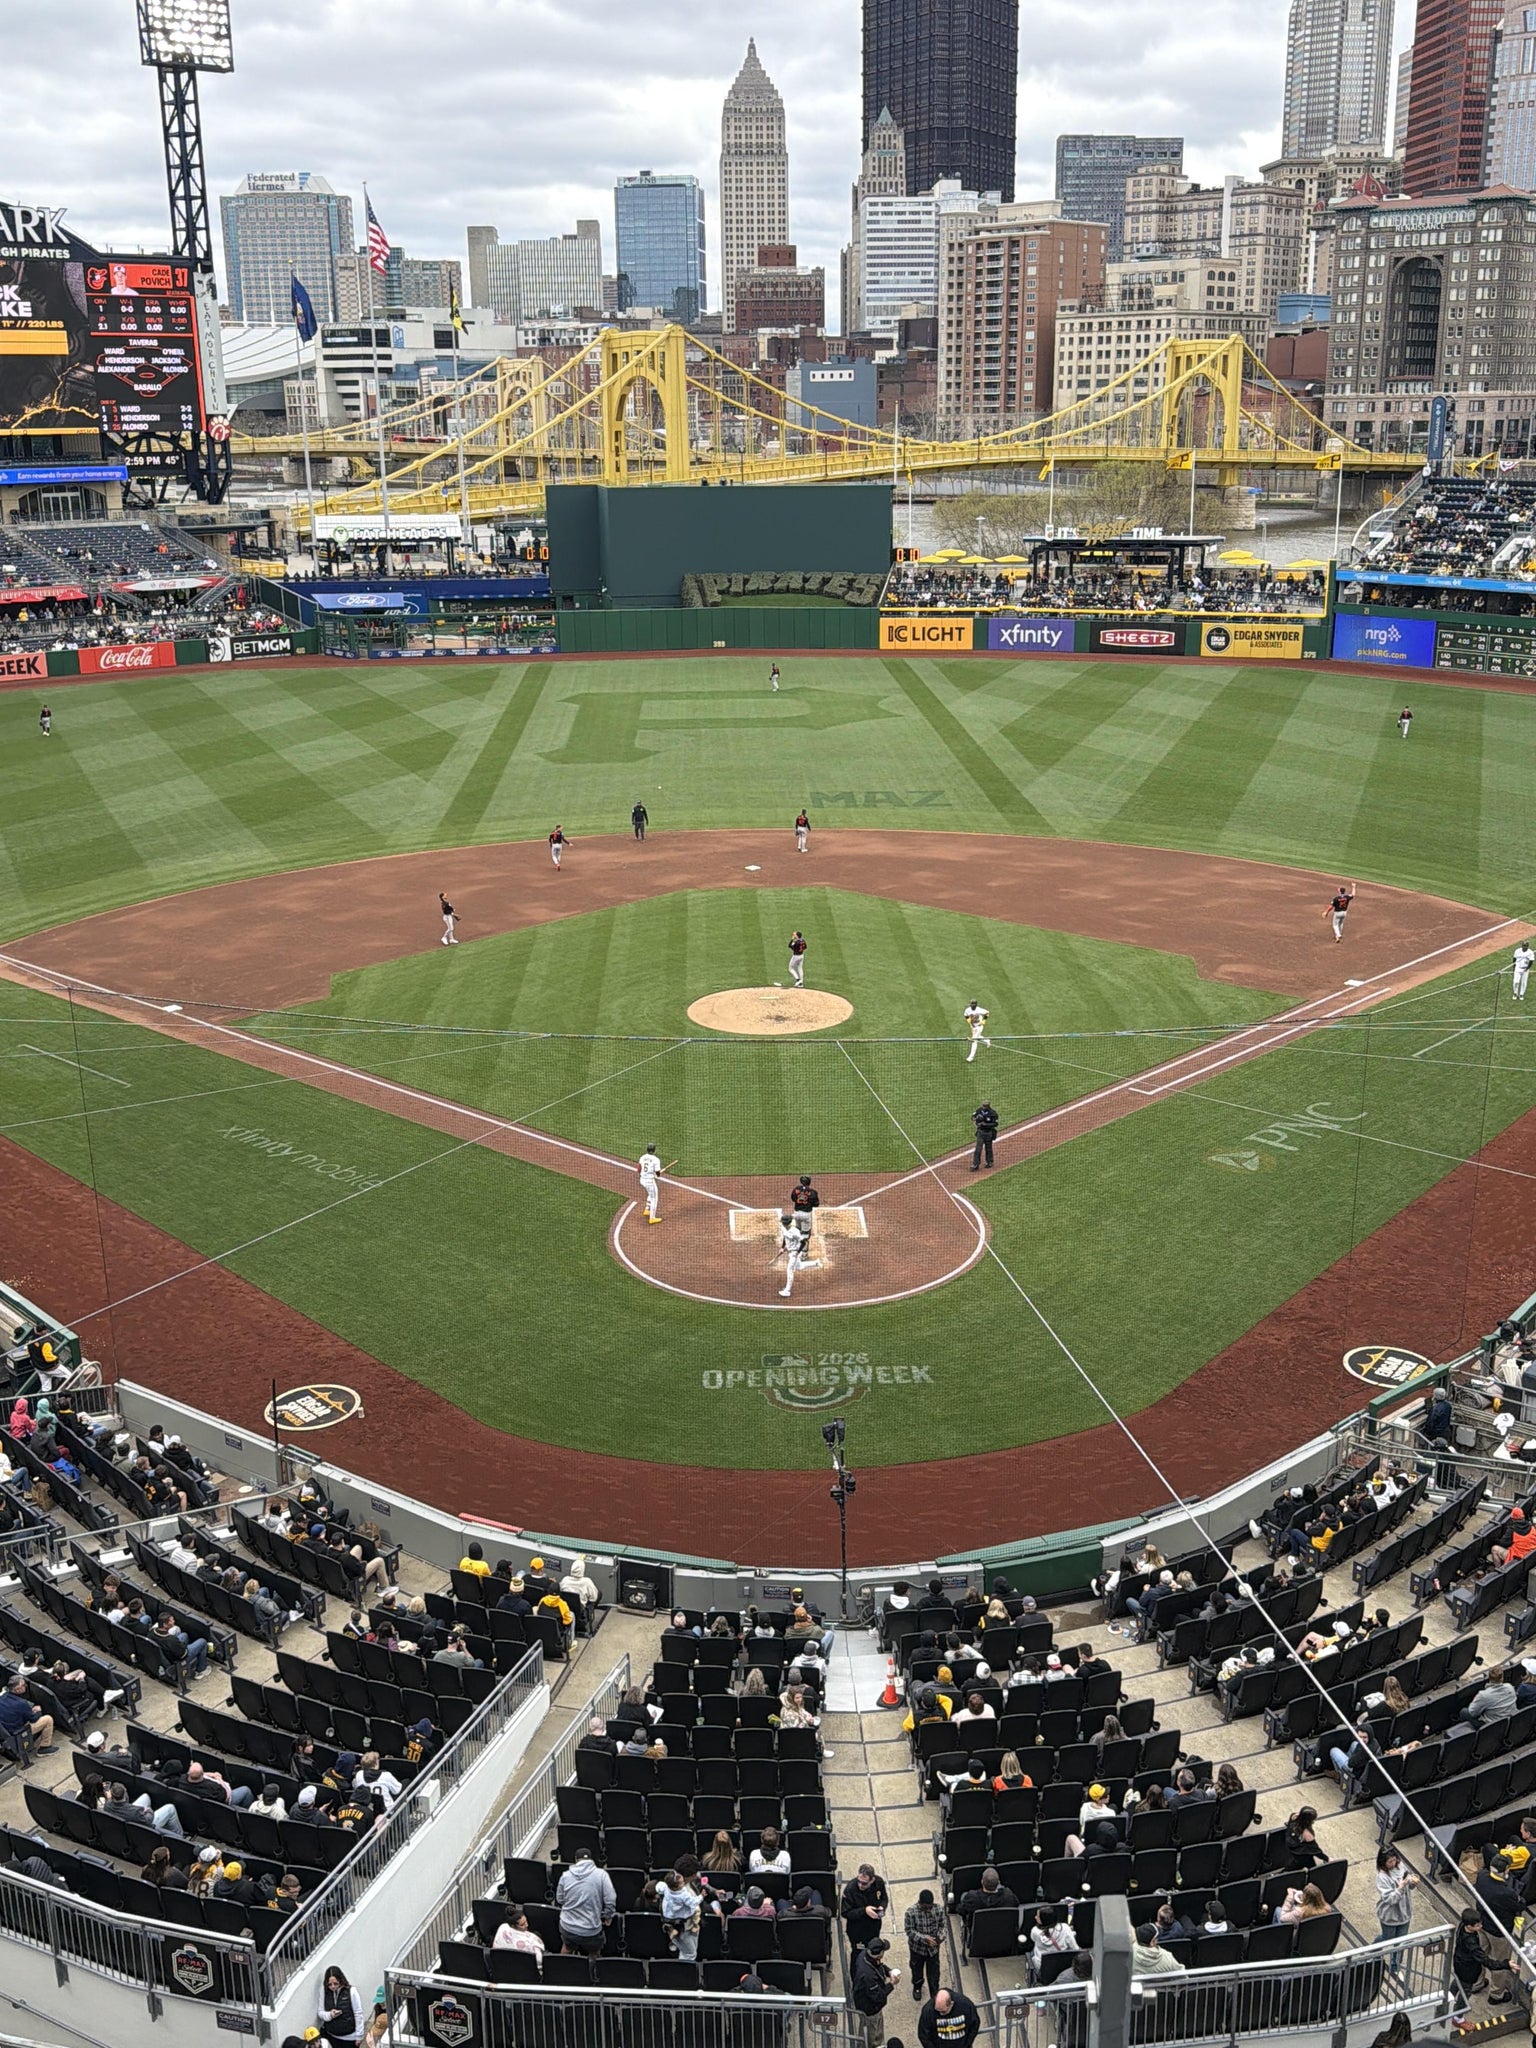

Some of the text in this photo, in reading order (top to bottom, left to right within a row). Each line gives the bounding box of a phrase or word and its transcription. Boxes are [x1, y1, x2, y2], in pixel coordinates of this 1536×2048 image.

[247, 172, 295, 181] Federated
[248, 182, 285, 191] Hermes
[1395, 222, 1445, 232] RENAISSANCE
[21, 247, 70, 259] PIRATES
[152, 268, 170, 276] CADE
[141, 277, 171, 286] POVICH
[0, 284, 21, 300] K
[0, 301, 32, 317] KE
[47, 320, 64, 328] LBS
[121, 323, 137, 331] 0.00
[125, 456, 180, 466] 2:59 PM 45°
[1331, 454, 1341, 467] P
[354, 527, 447, 540] FAT HEAD'S
[1057, 527, 1078, 539] IT'S
[1131, 527, 1163, 539] TIME
[345, 594, 378, 605] Ford
[912, 627, 965, 642] LIGHT
[1000, 624, 1063, 647] xfinity
[1105, 633, 1169, 643] SHEETZ
[1234, 631, 1300, 642] EDGAR SNYDER
[1365, 628, 1387, 645] nrg
[233, 638, 291, 655] BETMGM
[100, 646, 155, 670] Coca-Cola
[1357, 648, 1407, 660] pickNRG.com
[809, 790, 953, 809] MAZ
[1242, 1101, 1369, 1151] PNC
[216, 1124, 385, 1191] xfinity mobile
[702, 1364, 935, 1390] OPENING WEEK
[296, 1395, 332, 1418] EDGAR
[338, 1808, 364, 1820] GRIFFIN
[754, 1858, 784, 1868] STAELL
[177, 1956, 206, 1968] RE/MAX
[218, 2012, 251, 2025] CAUTION
[435, 2009, 466, 2019] RE/MAX
